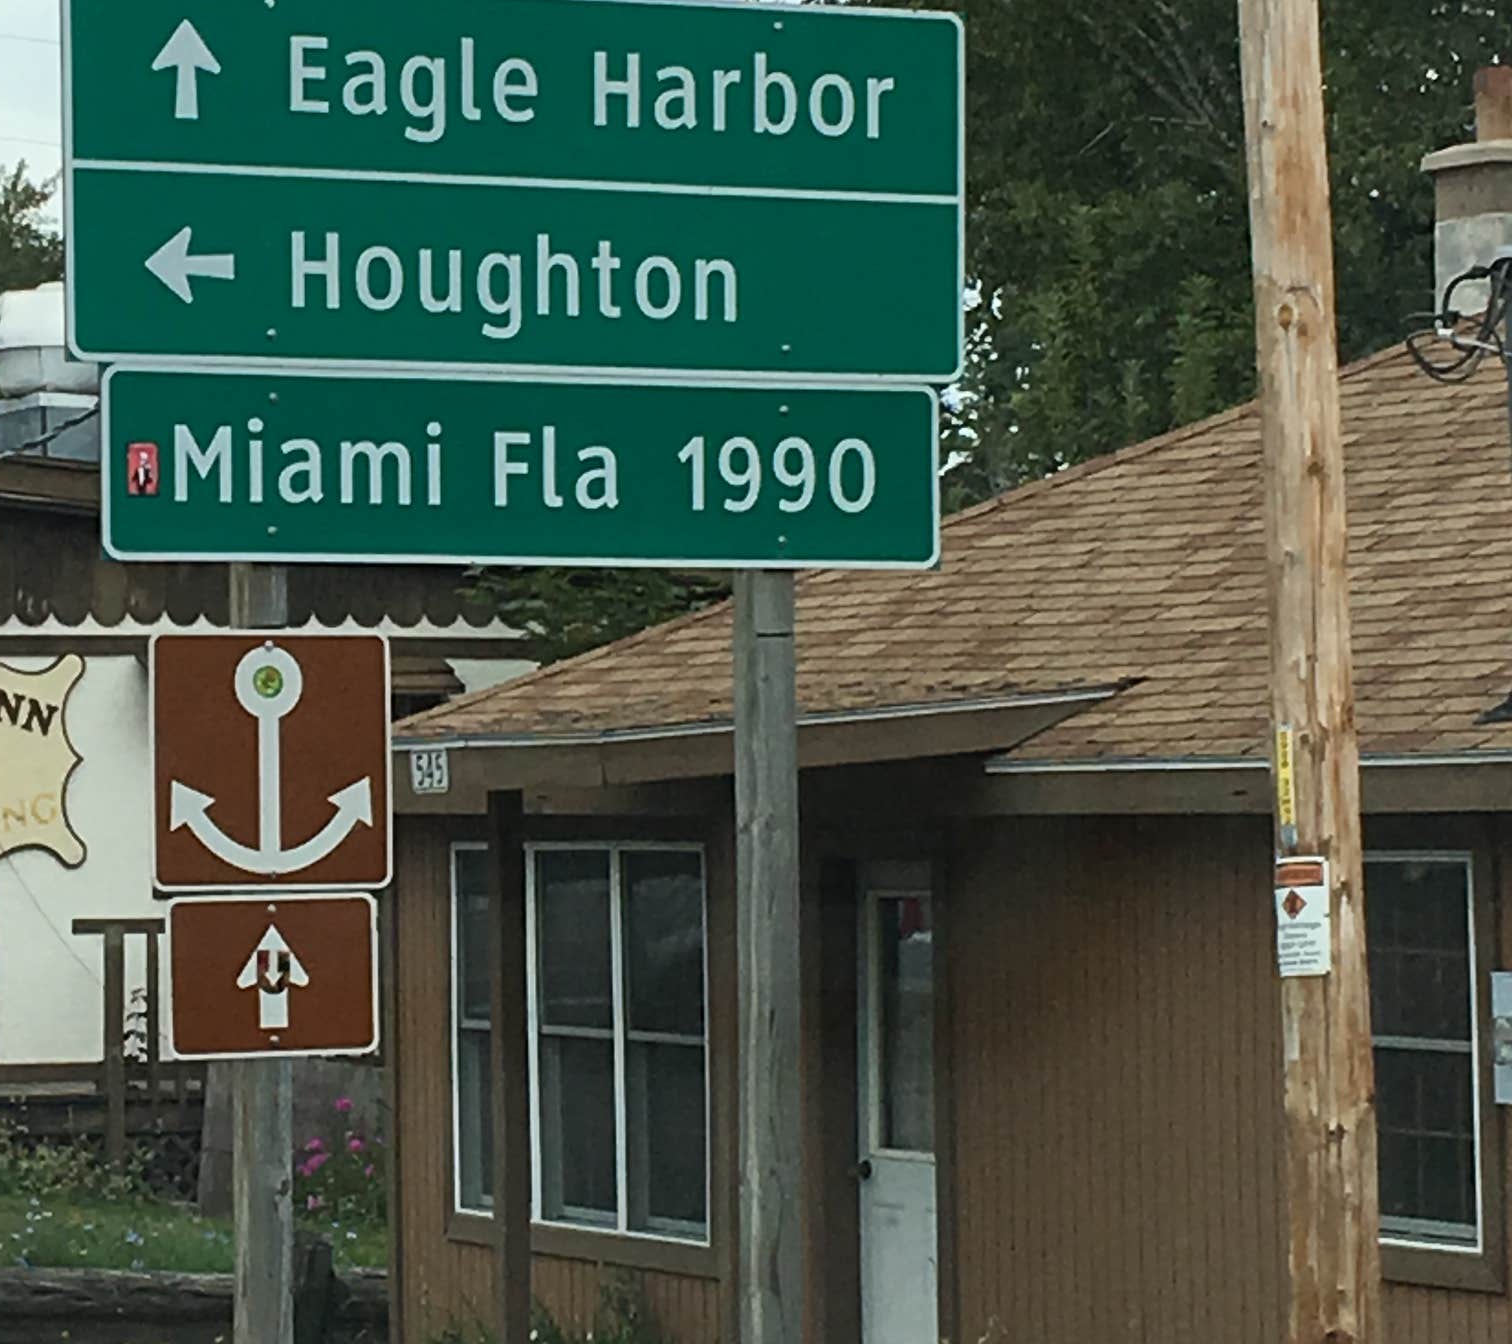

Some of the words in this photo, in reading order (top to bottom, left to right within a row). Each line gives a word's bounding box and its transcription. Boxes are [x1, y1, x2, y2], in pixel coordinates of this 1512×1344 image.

[288, 34, 540, 144] Eagle
[593, 50, 896, 139] Harbor
[290, 230, 740, 339] Houghton
[172, 417, 444, 506] Miami
[493, 426, 621, 510] Fla
[678, 436, 877, 513] 1990
[415, 752, 444, 787] 545
